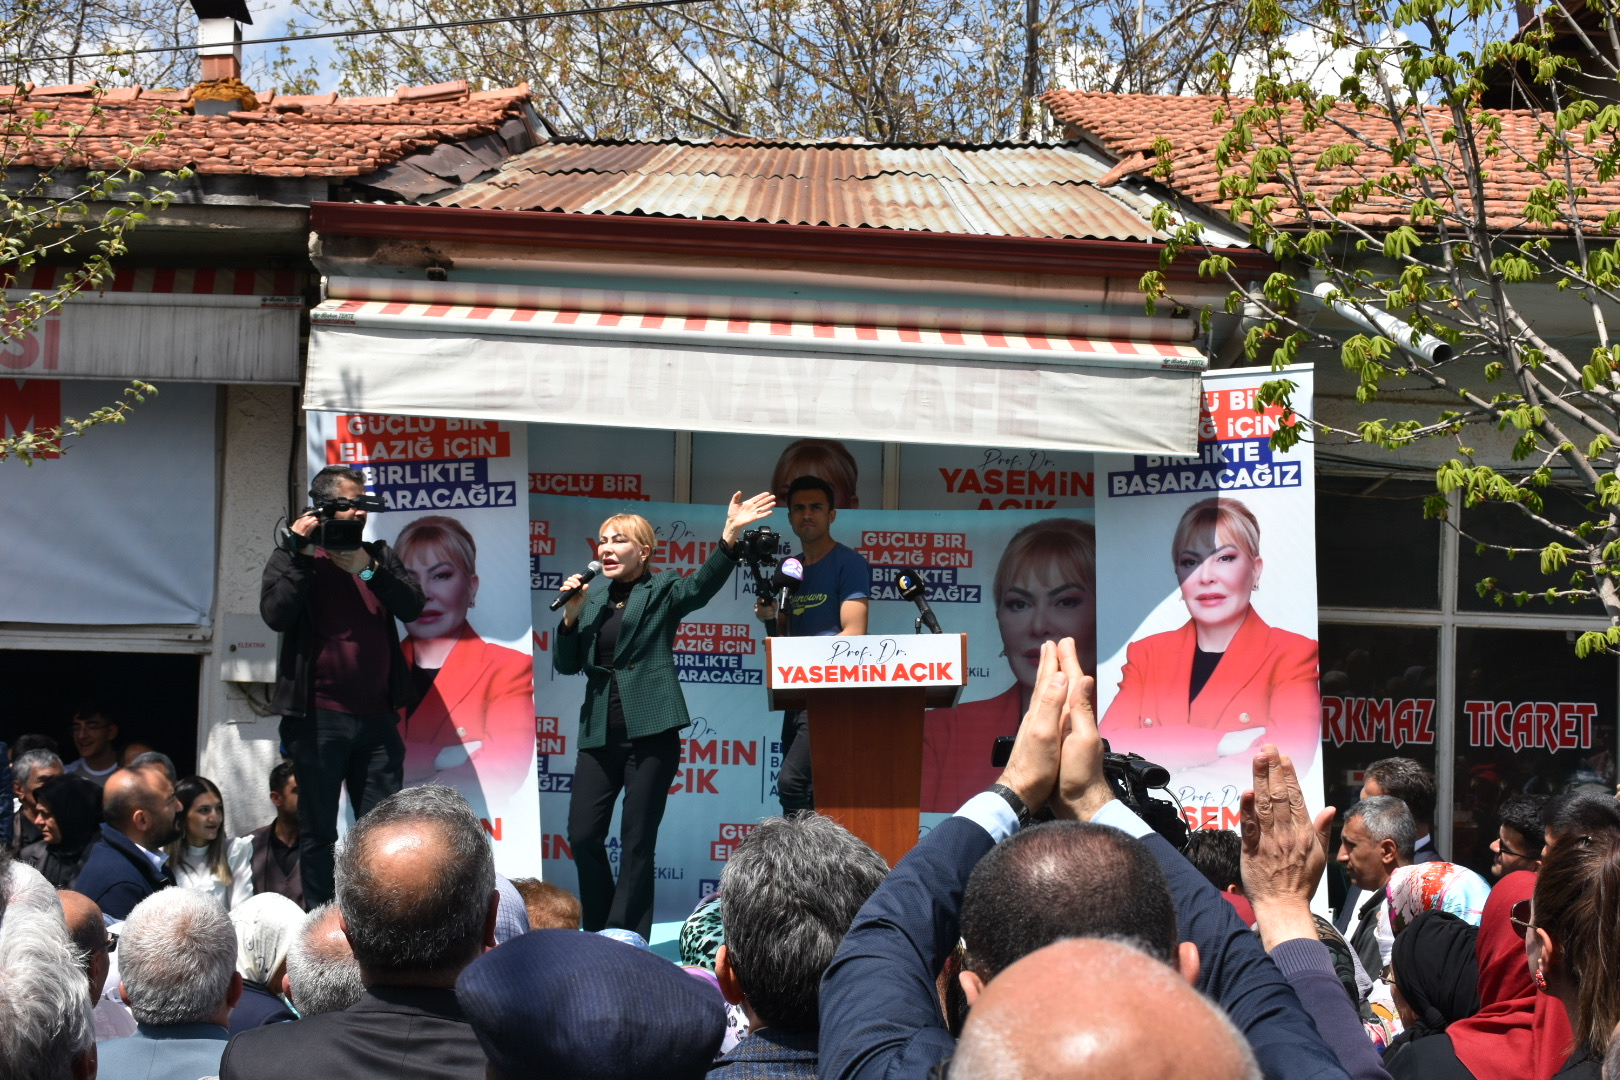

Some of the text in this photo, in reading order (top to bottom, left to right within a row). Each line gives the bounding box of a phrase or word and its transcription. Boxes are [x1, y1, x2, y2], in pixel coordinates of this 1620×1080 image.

[477, 340, 1041, 437] DOLUNAY CAFE
[347, 413, 436, 436] GÜÇLÜ
[339, 436, 497, 462] ELAZIĞ İÇİN
[978, 448, 1055, 472] Prof. Dr.
[361, 462, 475, 487] BİRLİKTE
[602, 475, 639, 492] BİR
[939, 467, 1095, 497] YASEMİN
[1113, 464, 1299, 495] BAŞARACAĞIZ
[863, 532, 963, 548] GÜÇLÜ BİR
[930, 552, 968, 567] İÇİN
[721, 624, 748, 638] BİR
[719, 640, 753, 654] İÇİN
[826, 638, 907, 666] Prof. Dr.
[777, 664, 887, 684] YASEMİN
[891, 661, 954, 683] AÇIK
[1463, 700, 1598, 755] TİCARET
